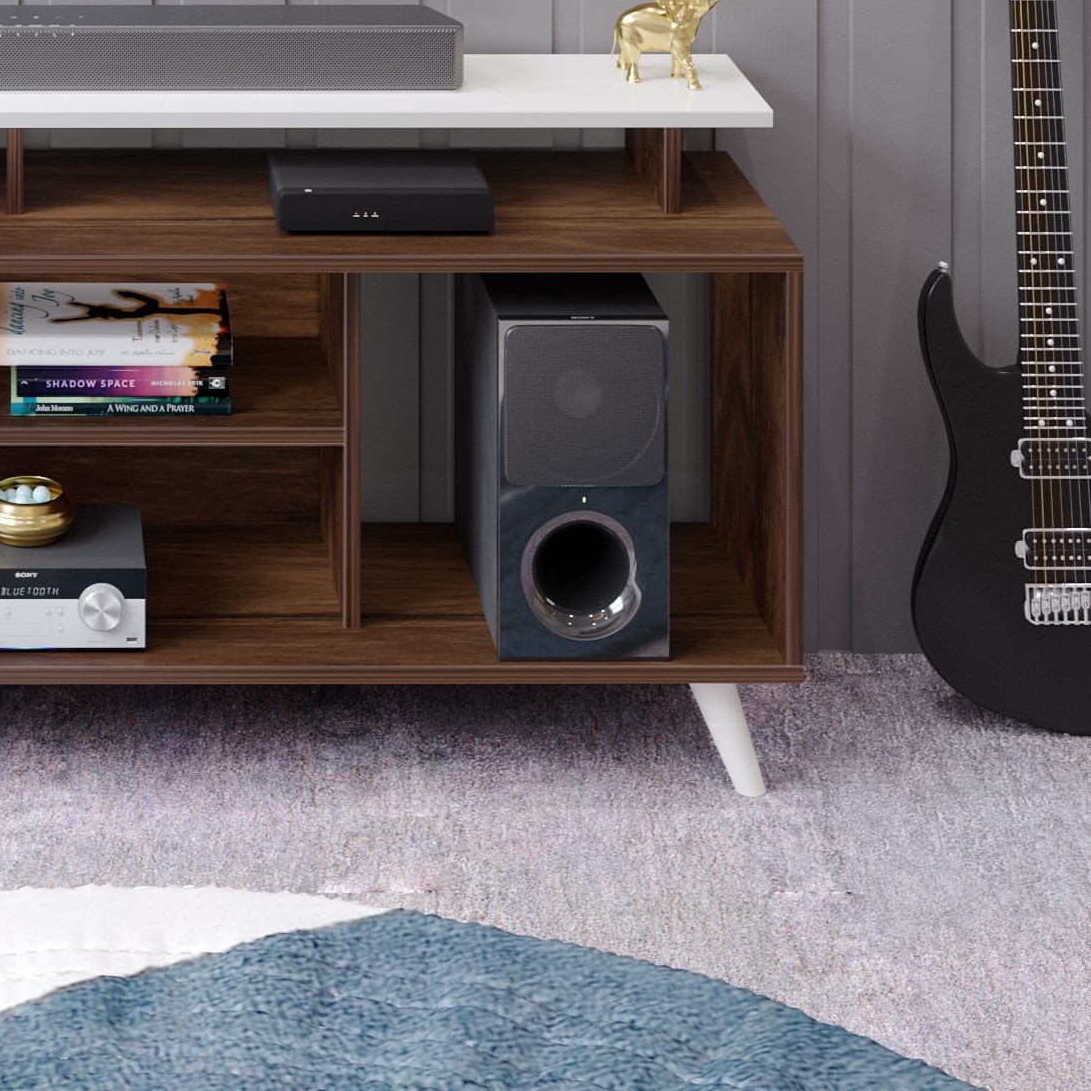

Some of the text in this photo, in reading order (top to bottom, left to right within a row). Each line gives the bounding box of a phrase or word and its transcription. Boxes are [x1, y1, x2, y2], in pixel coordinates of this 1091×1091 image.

[6, 348, 106, 358] DANCING INTO JOY
[45, 379, 136, 388] SHADOW SPACE
[35, 404, 50, 412] John
[107, 403, 114, 413] A
[140, 403, 158, 413] AND
[159, 403, 165, 413] A
[166, 403, 195, 413] PRAYER
[0, 586, 60, 597] BLUETOOTH
